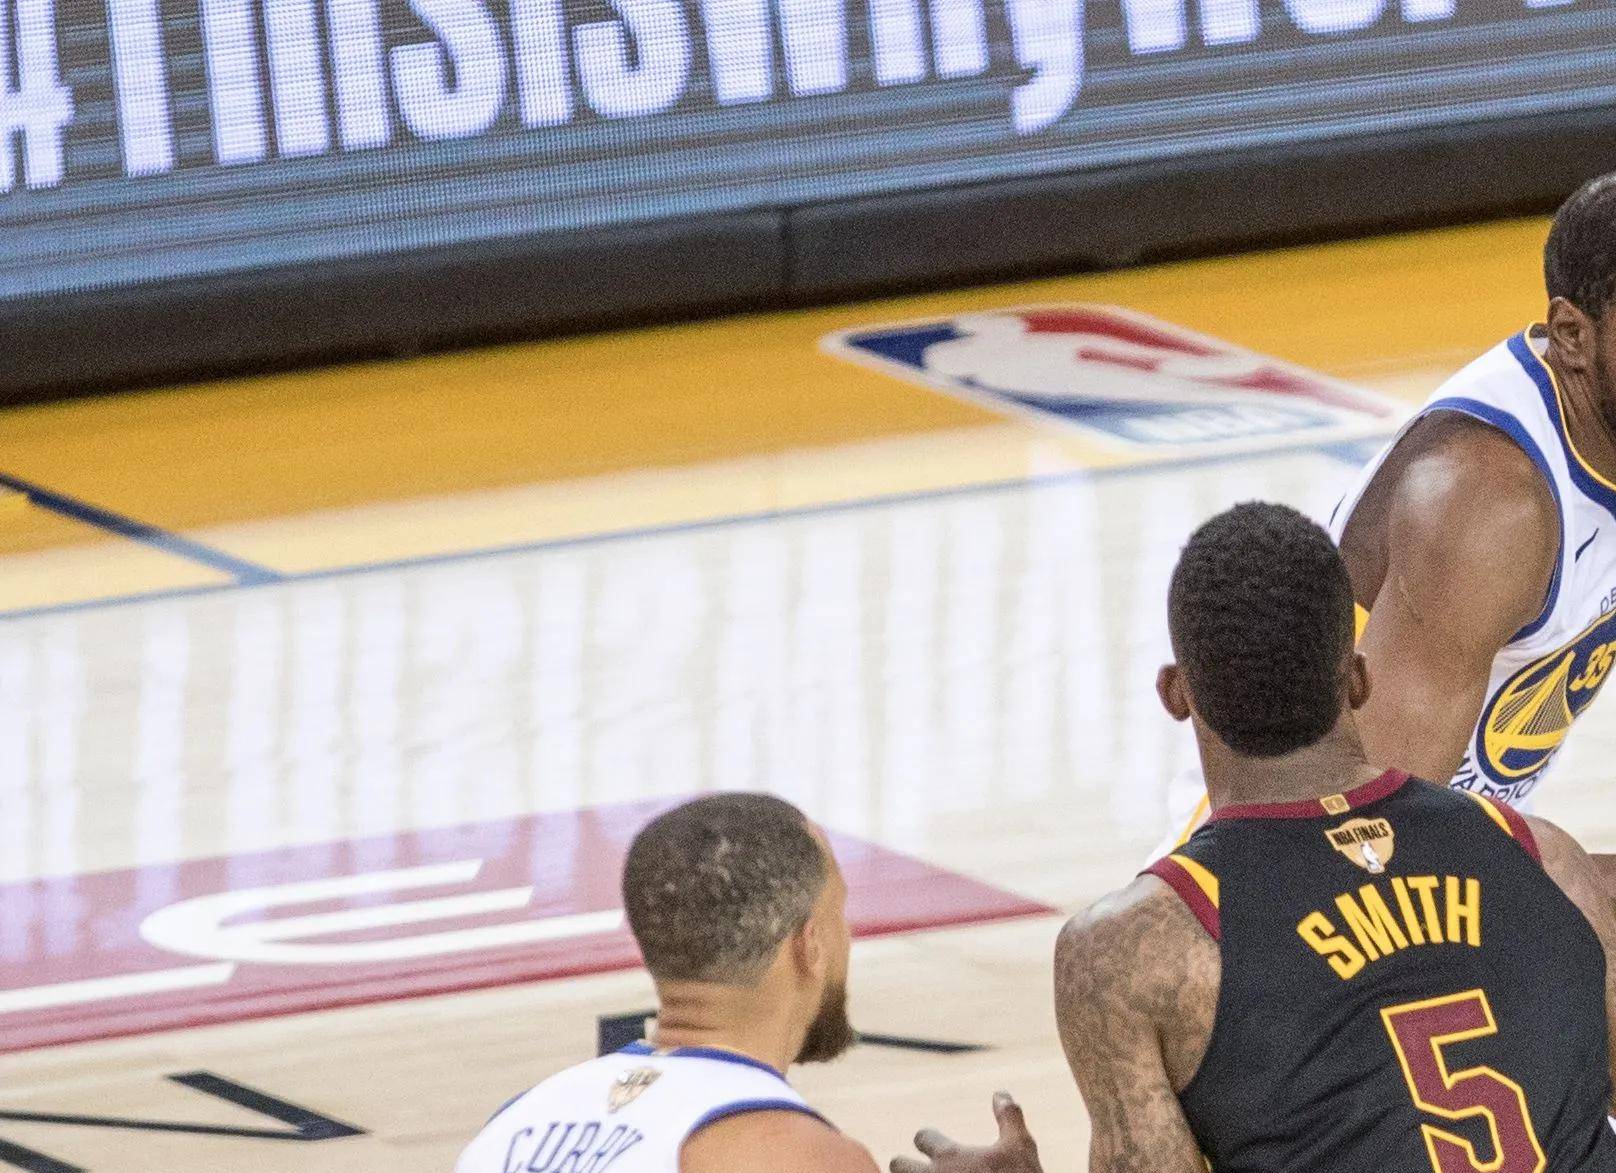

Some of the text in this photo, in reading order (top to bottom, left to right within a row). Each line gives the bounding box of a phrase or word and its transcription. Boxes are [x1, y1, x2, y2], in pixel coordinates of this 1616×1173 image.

[1331, 821, 1390, 846] NBA FINALS
[1296, 874, 1482, 981] SMITH
